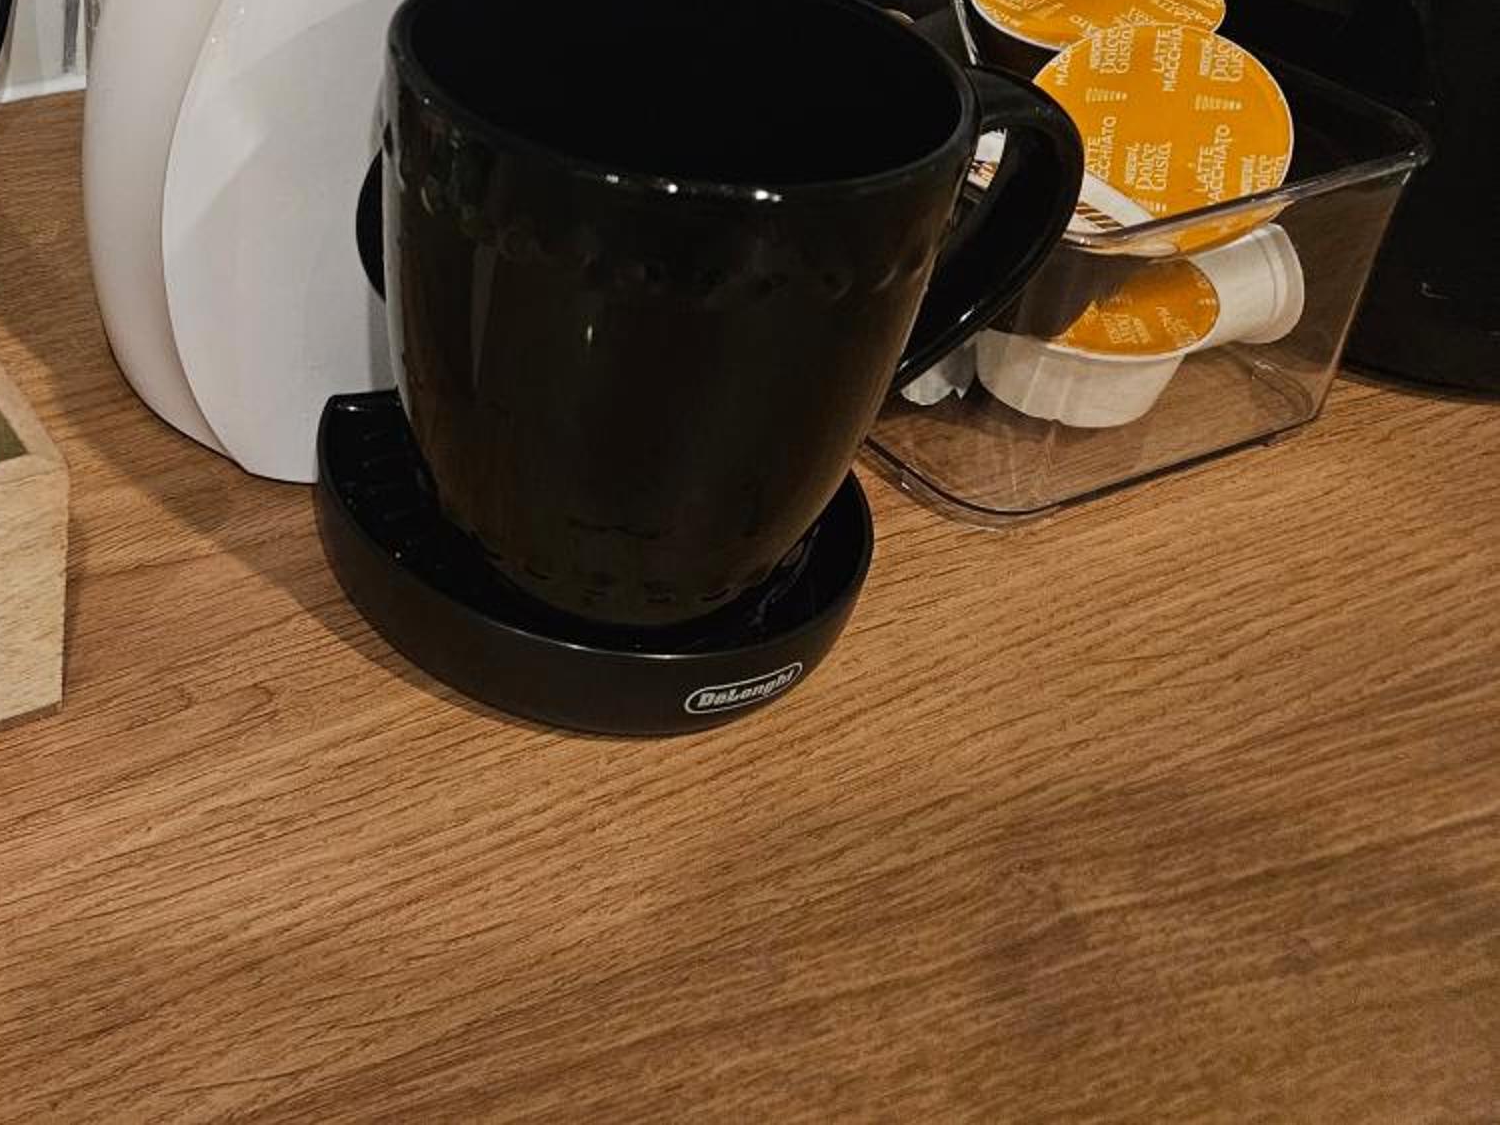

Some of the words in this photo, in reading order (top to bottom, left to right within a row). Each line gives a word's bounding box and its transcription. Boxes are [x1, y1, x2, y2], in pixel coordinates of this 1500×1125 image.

[1162, 21, 1183, 92] MACCHIA
[1209, 38, 1231, 82] Dolc
[1085, 135, 1100, 172] ATTE
[1098, 115, 1117, 180] CCHIATO
[1135, 142, 1156, 191] Dolce
[1151, 142, 1173, 192] Gusto
[1194, 145, 1213, 193] LATTE
[1205, 123, 1233, 203] ACCHIATO
